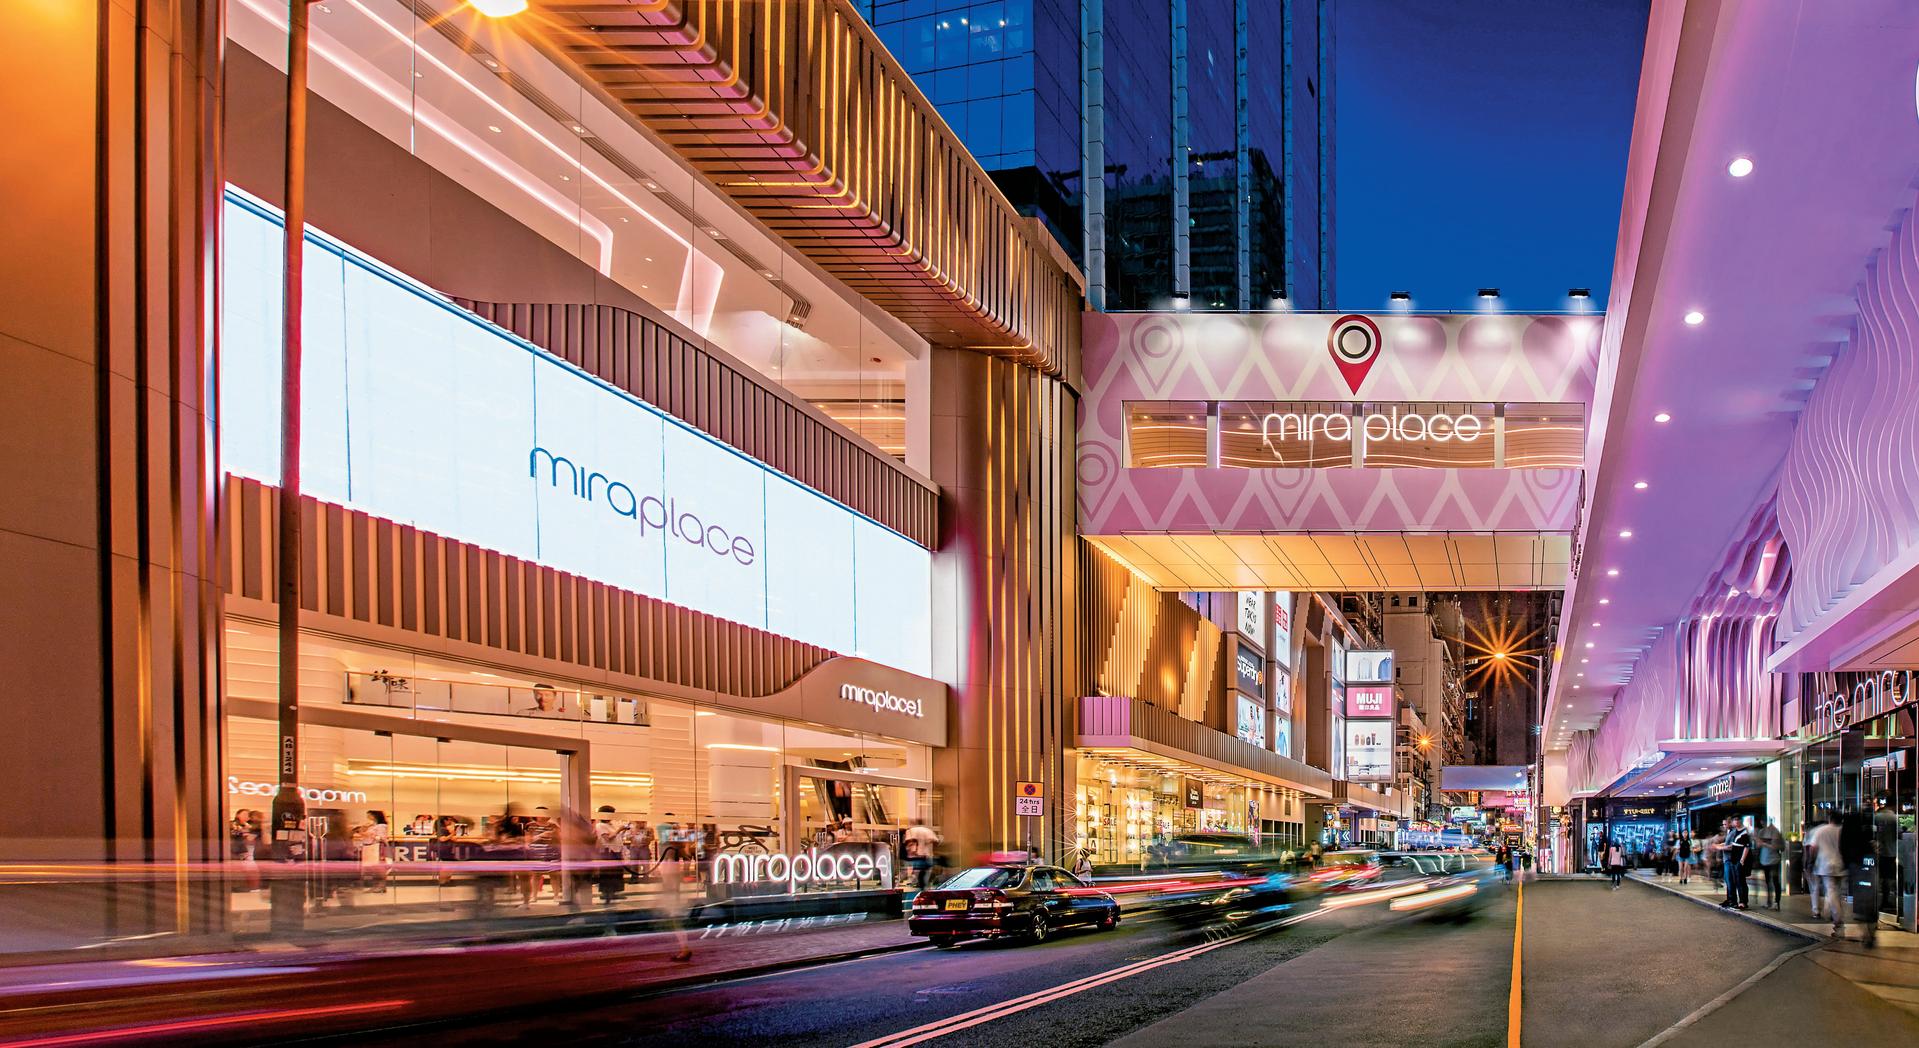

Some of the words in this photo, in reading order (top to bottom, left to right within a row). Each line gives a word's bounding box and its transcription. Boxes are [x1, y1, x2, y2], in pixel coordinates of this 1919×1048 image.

[1262, 412, 1353, 443] mira
[1363, 405, 1482, 459] place
[529, 447, 755, 566] miraplace
[840, 683, 924, 718] miraplace1
[1356, 692, 1383, 705] MUJI
[1815, 691, 1848, 738] the
